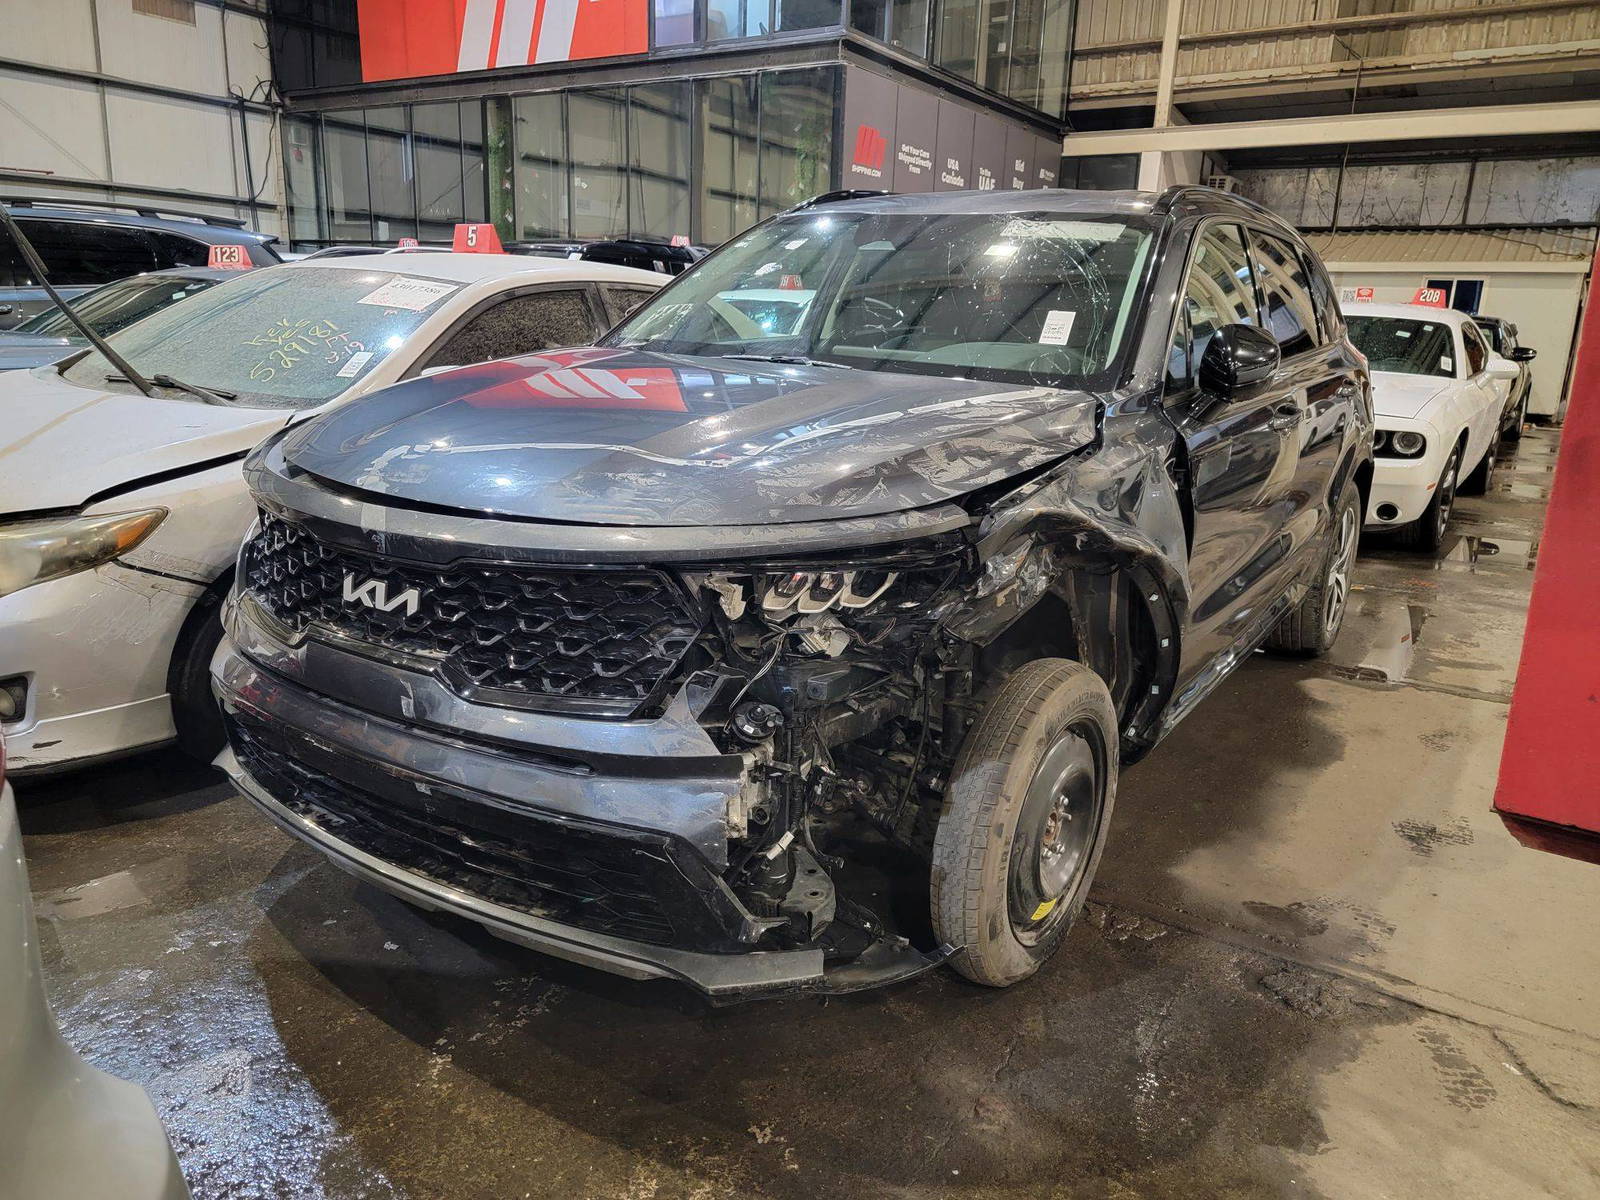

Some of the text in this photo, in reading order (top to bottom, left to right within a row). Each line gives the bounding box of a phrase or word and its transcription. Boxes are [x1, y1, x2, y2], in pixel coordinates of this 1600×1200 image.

[898, 152, 932, 170] Shipped Directly
[909, 164, 921, 174] From
[947, 158, 959, 171] USA
[1015, 159, 1025, 172] Bid
[941, 171, 964, 187] Canada
[467, 225, 477, 247] 5
[214, 247, 239, 263] 123
[1419, 288, 1441, 303] 208
[250, 319, 338, 382] 529181
